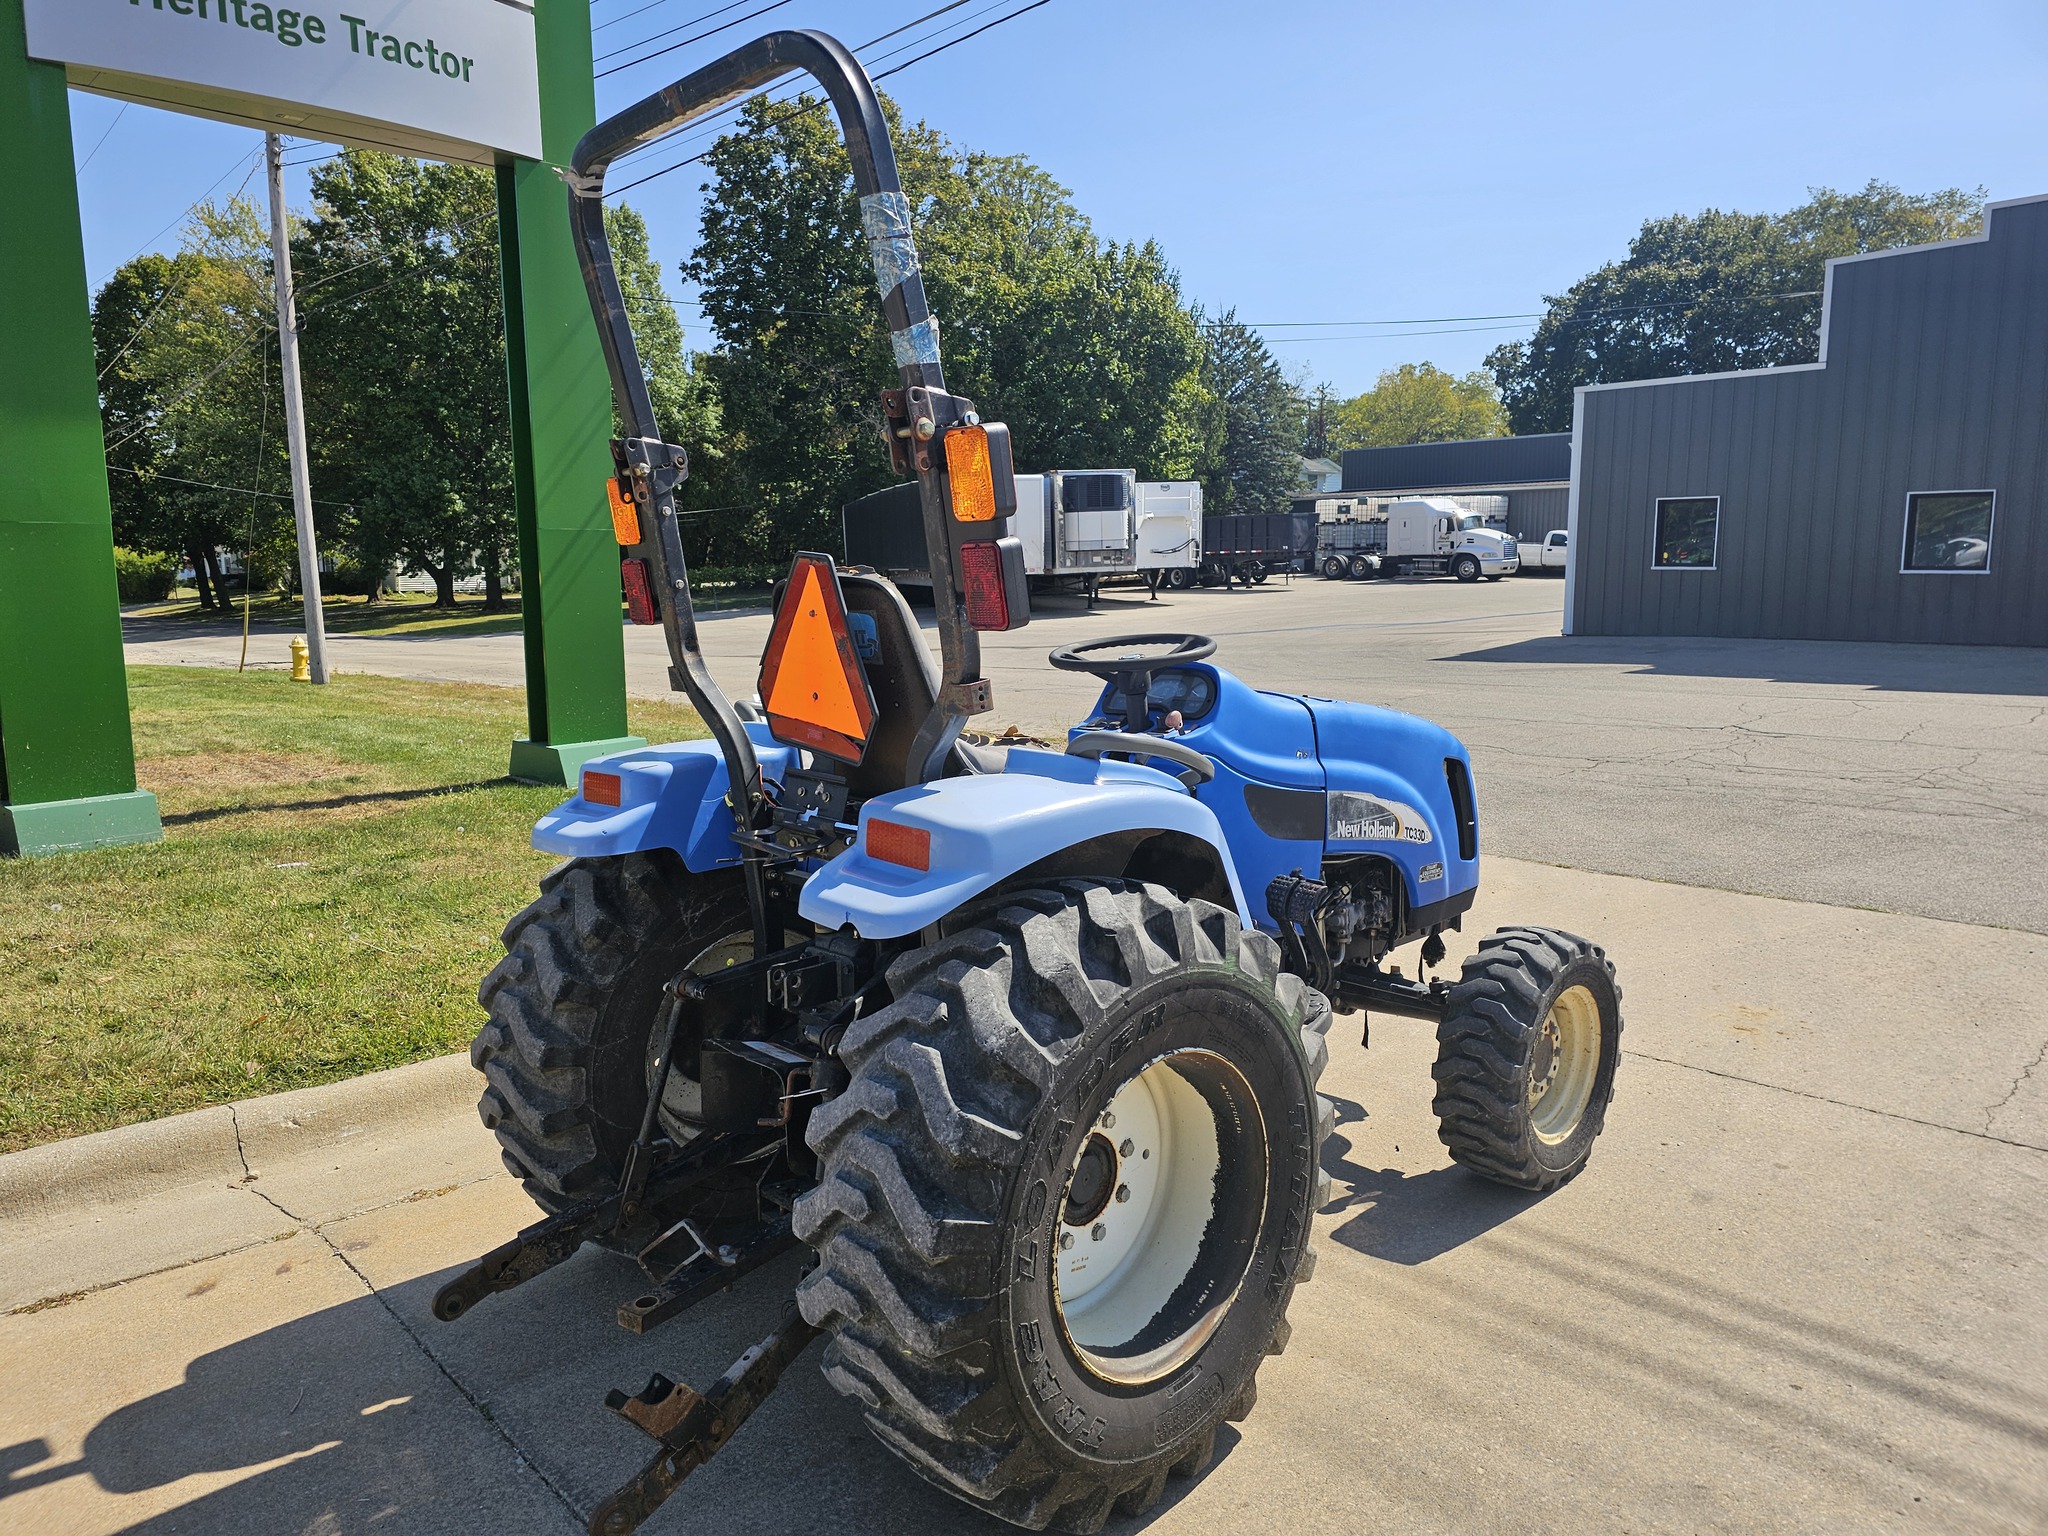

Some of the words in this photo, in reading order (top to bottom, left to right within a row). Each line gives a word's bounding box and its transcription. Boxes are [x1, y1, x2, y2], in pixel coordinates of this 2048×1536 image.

[128, 0, 326, 47] eritage
[340, 13, 474, 83] Tractor
[1337, 820, 1360, 838] New
[1361, 820, 1396, 838] Holland
[1404, 826, 1426, 841] TC33D
[1018, 1002, 1167, 1280] LOADER
[1265, 1102, 1310, 1302] TITAN
[1018, 1319, 1108, 1449] TRAC
